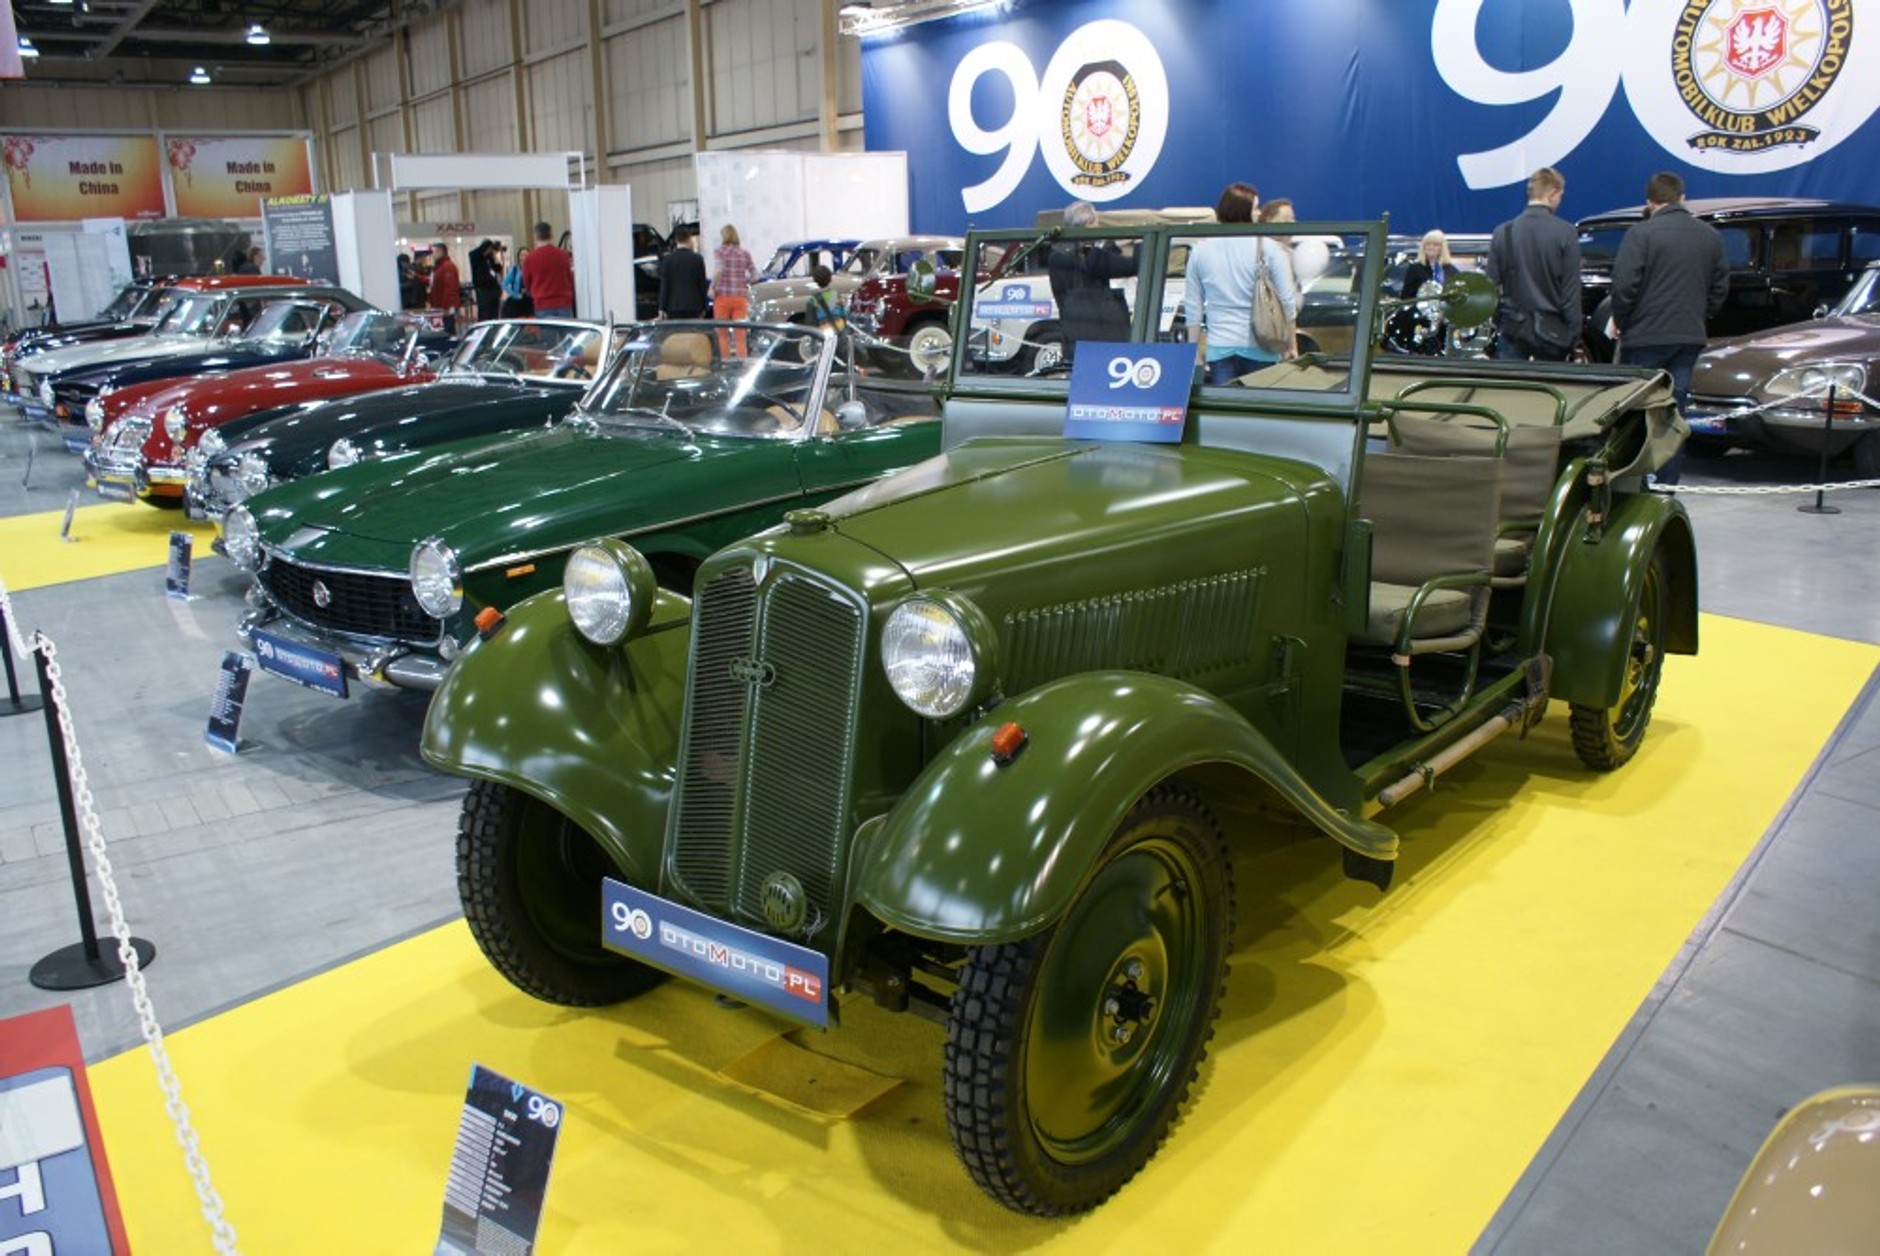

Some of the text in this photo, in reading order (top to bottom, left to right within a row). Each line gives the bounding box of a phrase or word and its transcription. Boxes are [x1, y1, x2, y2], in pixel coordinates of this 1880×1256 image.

[1431, 0, 1880, 190] 90
[948, 18, 1169, 213] 90
[69, 160, 123, 174] Made in
[226, 160, 275, 174] Made in
[79, 181, 119, 195] China
[235, 180, 271, 194] China
[1007, 287, 1026, 300] 90
[1108, 357, 1161, 389] 90
[257, 638, 274, 659] 90
[611, 902, 652, 940] 90
[528, 1095, 560, 1128] 90
